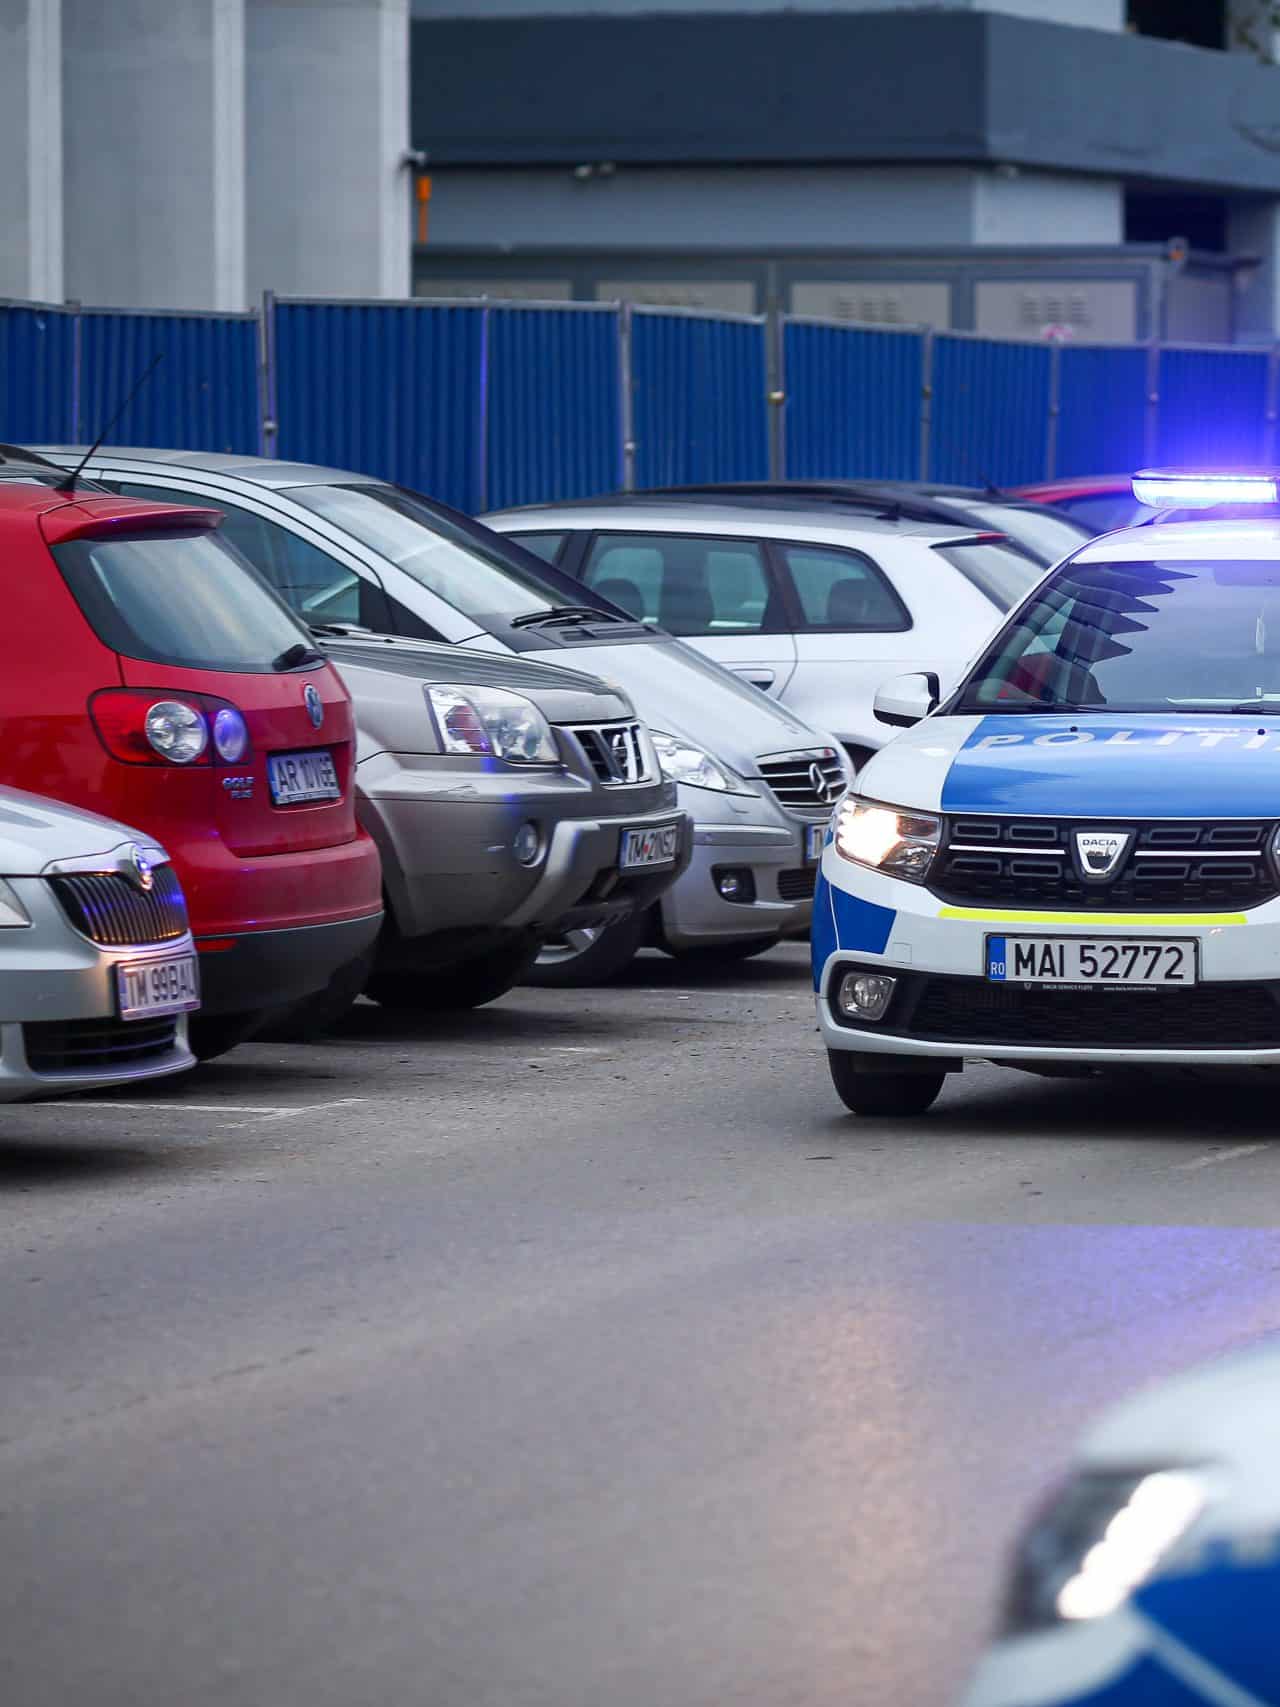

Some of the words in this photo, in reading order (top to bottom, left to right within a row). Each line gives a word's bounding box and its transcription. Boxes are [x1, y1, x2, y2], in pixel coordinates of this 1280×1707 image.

[277, 759, 300, 792] AR
[990, 961, 1005, 976] RO
[1014, 943, 1065, 978] MAI
[1079, 944, 1184, 980] 52772
[126, 970, 148, 1007] TM
